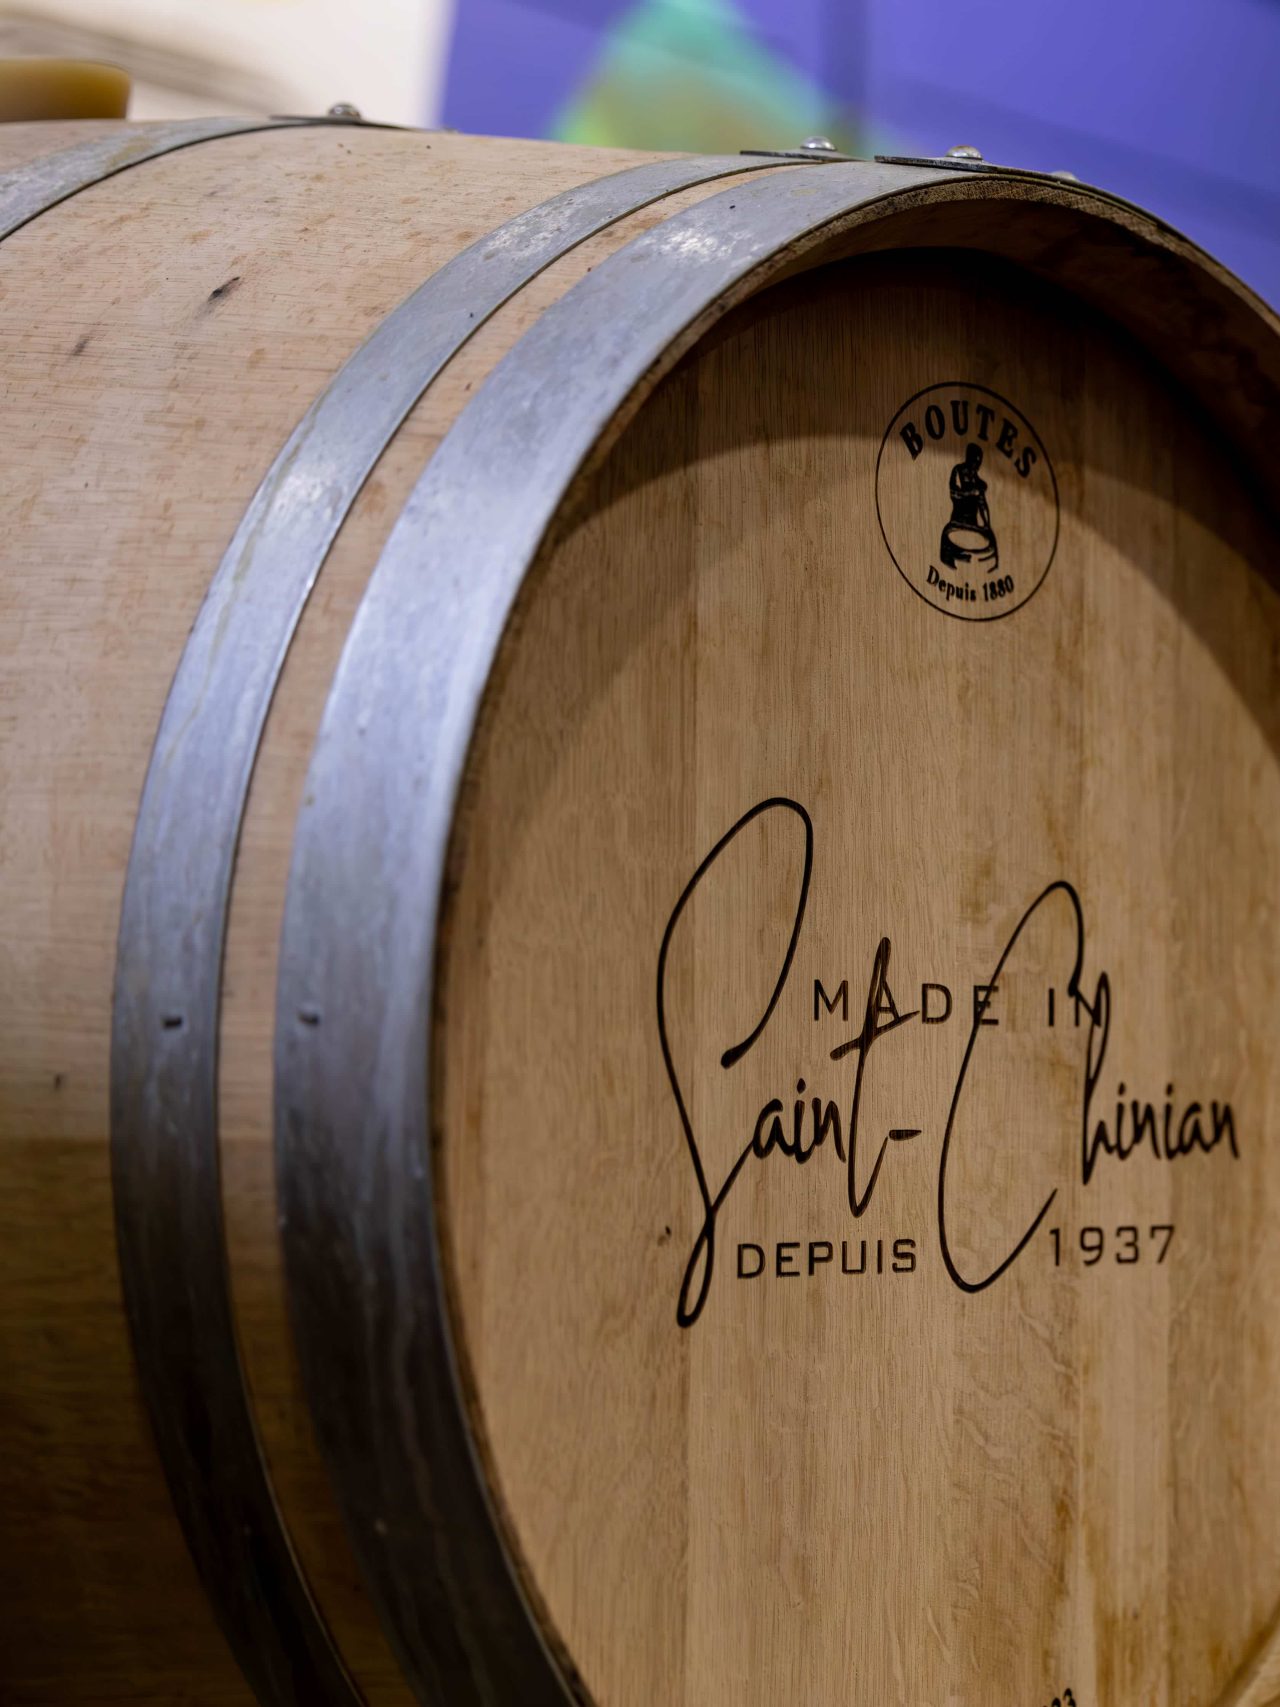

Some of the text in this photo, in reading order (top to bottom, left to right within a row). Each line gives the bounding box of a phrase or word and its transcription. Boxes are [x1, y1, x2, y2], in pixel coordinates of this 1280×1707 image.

[899, 400, 1037, 478] BOUTES
[926, 565, 1015, 602] Depuis 1880
[813, 978, 1103, 1028] MADE IN
[736, 1224, 1176, 1280] DEPUIS 1937
